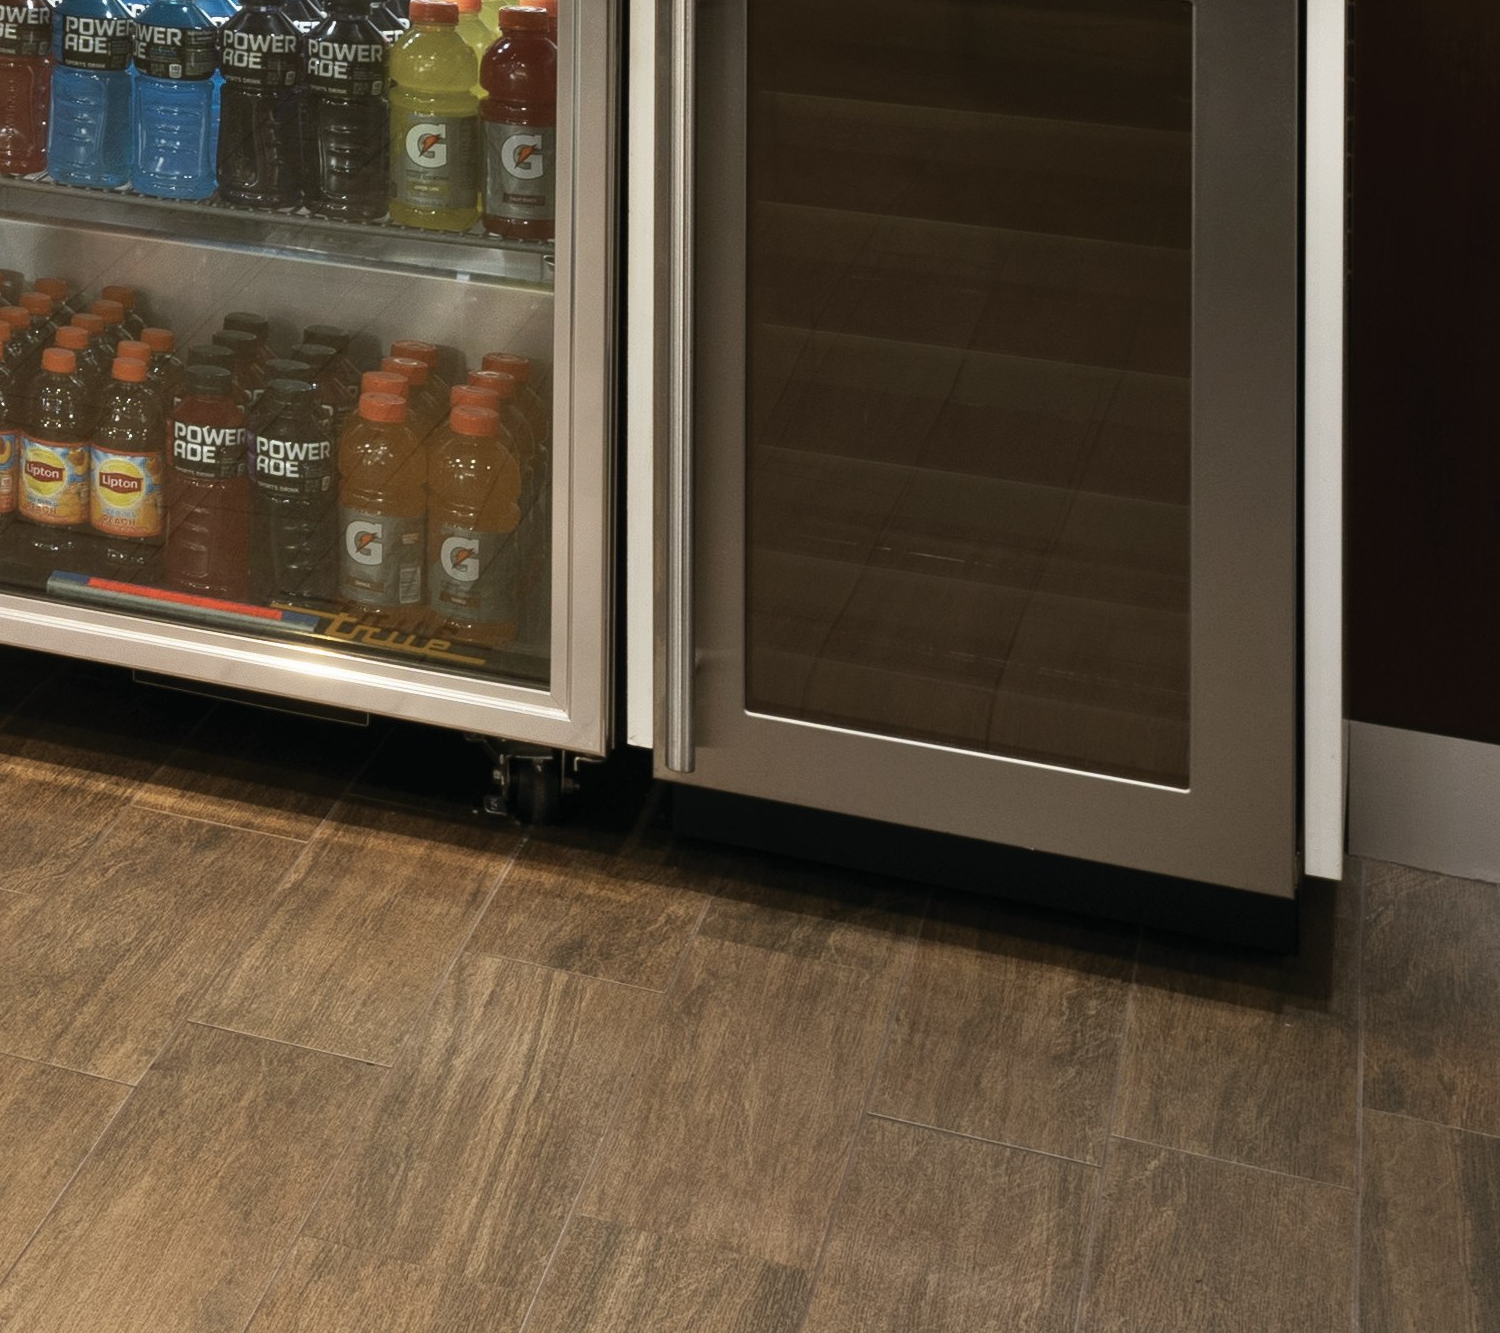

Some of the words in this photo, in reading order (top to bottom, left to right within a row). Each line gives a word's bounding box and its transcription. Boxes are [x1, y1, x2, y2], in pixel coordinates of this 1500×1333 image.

[65, 15, 136, 37] POWER
[64, 36, 107, 54] ADE
[223, 29, 296, 54] POWER
[308, 38, 384, 63] POWER
[223, 51, 262, 70] ADE
[308, 60, 350, 80] ADE
[405, 124, 447, 168] G
[502, 134, 543, 180] G
[174, 422, 247, 446] POWER
[173, 442, 216, 464] ADE
[256, 436, 331, 461] POWER
[26, 464, 60, 480] Lipton
[256, 456, 300, 478] ADE
[102, 474, 138, 490] Lipton
[103, 514, 136, 526] PEACH
[345, 520, 383, 565] G
[441, 536, 479, 582] G
